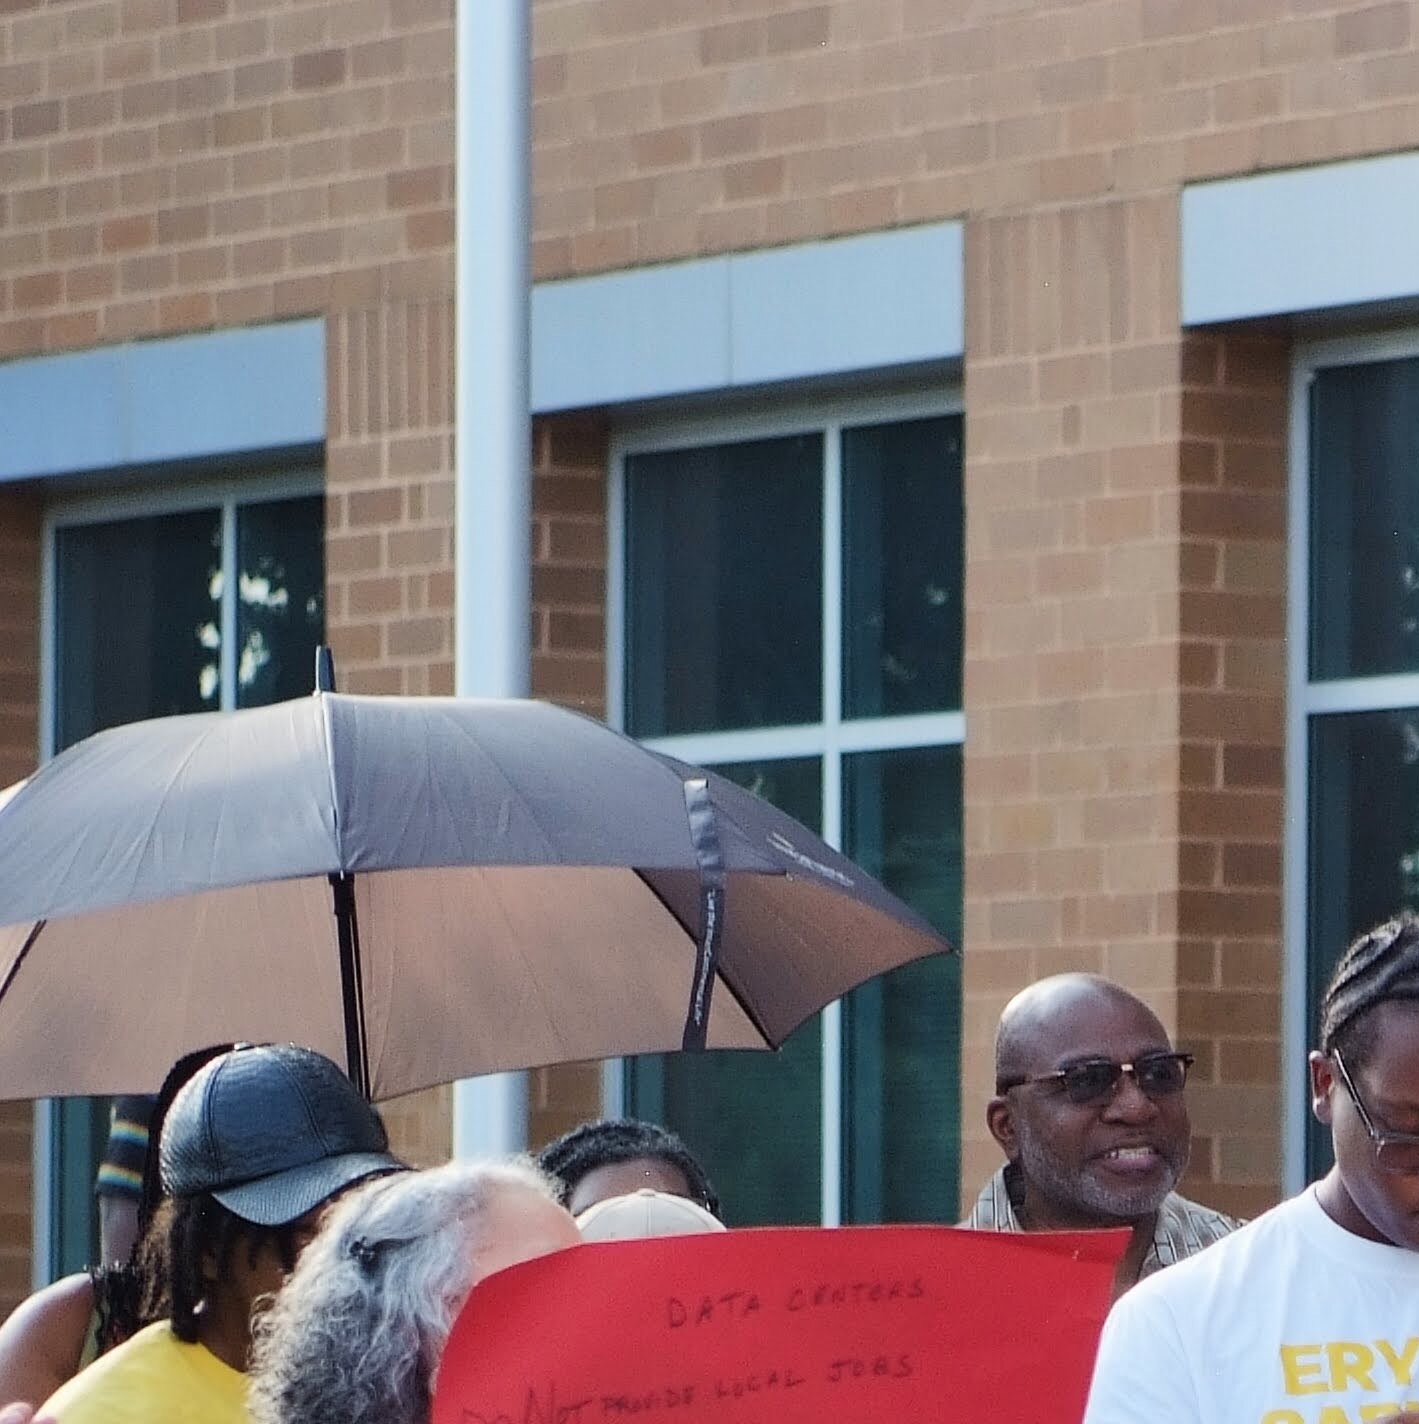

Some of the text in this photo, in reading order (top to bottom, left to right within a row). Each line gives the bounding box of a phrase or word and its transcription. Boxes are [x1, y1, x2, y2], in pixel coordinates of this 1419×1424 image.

[665, 1277, 925, 1329] DATA CENTERS
[601, 1384, 697, 1416] PROVIDE
[714, 1369, 805, 1399] LOCAL
[827, 1353, 914, 1383] JOBS
